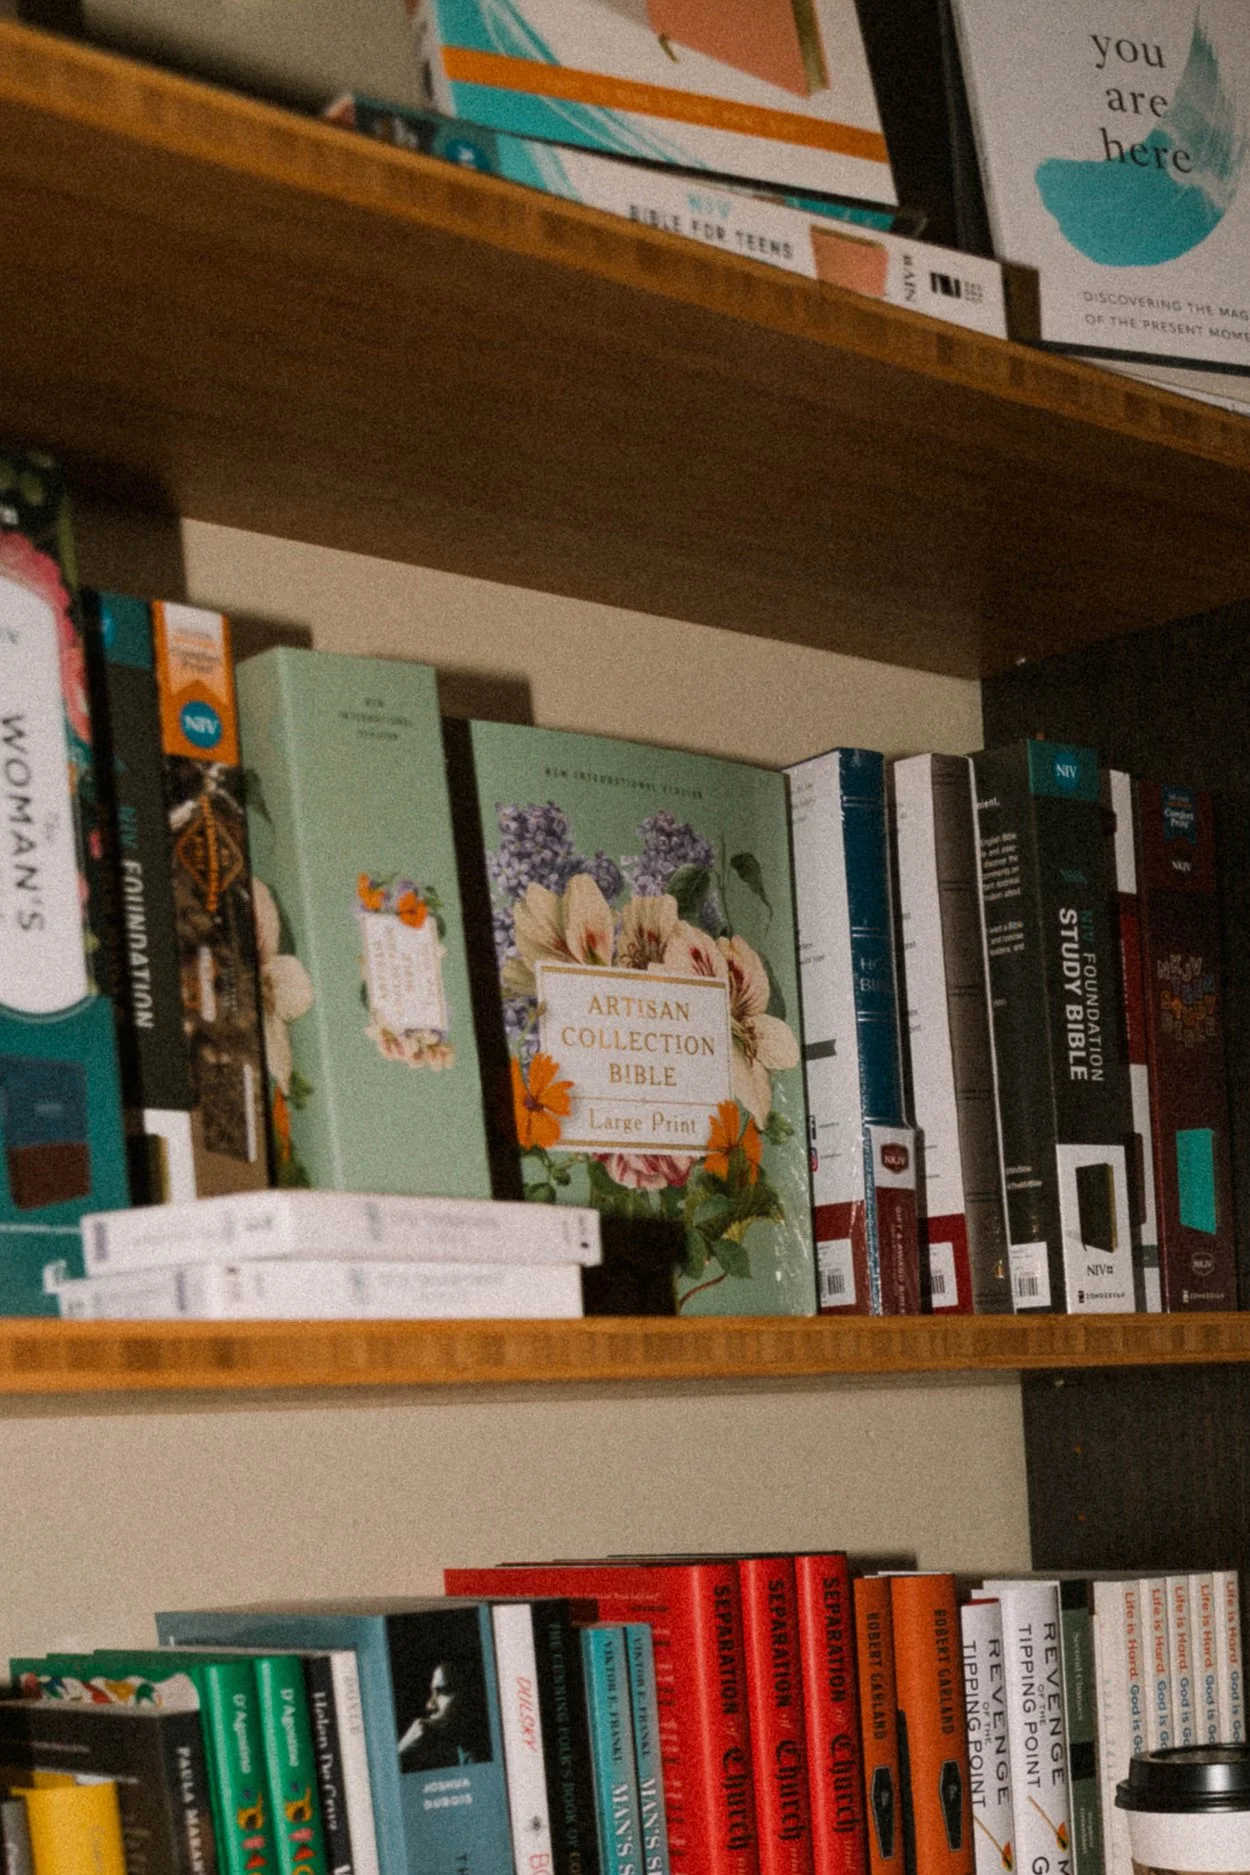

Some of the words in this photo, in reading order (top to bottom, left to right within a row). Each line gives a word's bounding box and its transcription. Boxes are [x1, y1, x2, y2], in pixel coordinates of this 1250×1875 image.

[1091, 34, 1166, 69] you
[1105, 87, 1168, 118] are
[1100, 128, 1193, 173] here
[628, 205, 681, 233] BIBLE
[691, 220, 726, 241] FOR
[736, 231, 793, 258] TEENS
[1084, 291, 1182, 312] DISCOVERING
[1187, 302, 1212, 315] THE
[1085, 314, 1103, 326] OF
[1111, 316, 1136, 329] THE
[1143, 320, 1201, 335] PRESENT
[1056, 764, 1077, 778] NIV
[0, 714, 44, 932] WOMAN'S
[1058, 905, 1082, 996] STUDY
[588, 995, 689, 1021] ARTISAN
[1082, 951, 1104, 1081] FOUNDATION
[561, 1026, 715, 1056] COLLECTION
[1064, 1002, 1088, 1081] BIBLE
[609, 1062, 677, 1086] BIBLE
[589, 1108, 642, 1133] Large
[652, 1112, 696, 1133] Print
[1124, 1591, 1136, 1618] Life
[1151, 1589, 1163, 1614] Life
[1175, 1586, 1185, 1612] Life
[1200, 1585, 1211, 1610] Life
[1225, 1581, 1236, 1606] Life
[1126, 1623, 1136, 1633] is
[1153, 1620, 1163, 1630] is
[1176, 1617, 1186, 1627] is
[1202, 1615, 1211, 1625] is
[1227, 1611, 1237, 1621] is
[713, 1583, 738, 1714] SEPARATION
[767, 1579, 791, 1707] SEPARATION
[822, 1576, 846, 1702] SEPARATION
[865, 1612, 881, 1666] ROBERT
[933, 1608, 950, 1662] ROBERT
[1018, 1623, 1036, 1712] TIPPING
[938, 1667, 956, 1733] GARLAND
[961, 1640, 981, 1731] TIPPING
[1036, 1683, 1045, 1698] OF
[1129, 1684, 1140, 1714] God
[1155, 1681, 1167, 1710] God
[1179, 1677, 1190, 1707] God
[1204, 1675, 1215, 1704] God
[1229, 1671, 1240, 1700] God
[869, 1672, 886, 1739] GARLAND
[981, 1701, 990, 1716] OF
[1038, 1704, 1046, 1724] THE
[1043, 1622, 1065, 1785] REVENGE
[1181, 1712, 1190, 1722] is
[1206, 1709, 1215, 1719] is
[1231, 1705, 1241, 1715] is
[983, 1721, 992, 1744] THE
[988, 1639, 1009, 1805] REVENGE
[1130, 1719, 1141, 1730] is
[1157, 1715, 1167, 1725] is
[1023, 1721, 1040, 1788] POINT
[827, 1733, 860, 1833] Church
[968, 1739, 987, 1807] POINT
[719, 1746, 752, 1851] Church
[773, 1738, 807, 1841] Church
[608, 1782, 634, 1858] MAN'S
[635, 1776, 661, 1849] MAN'S
